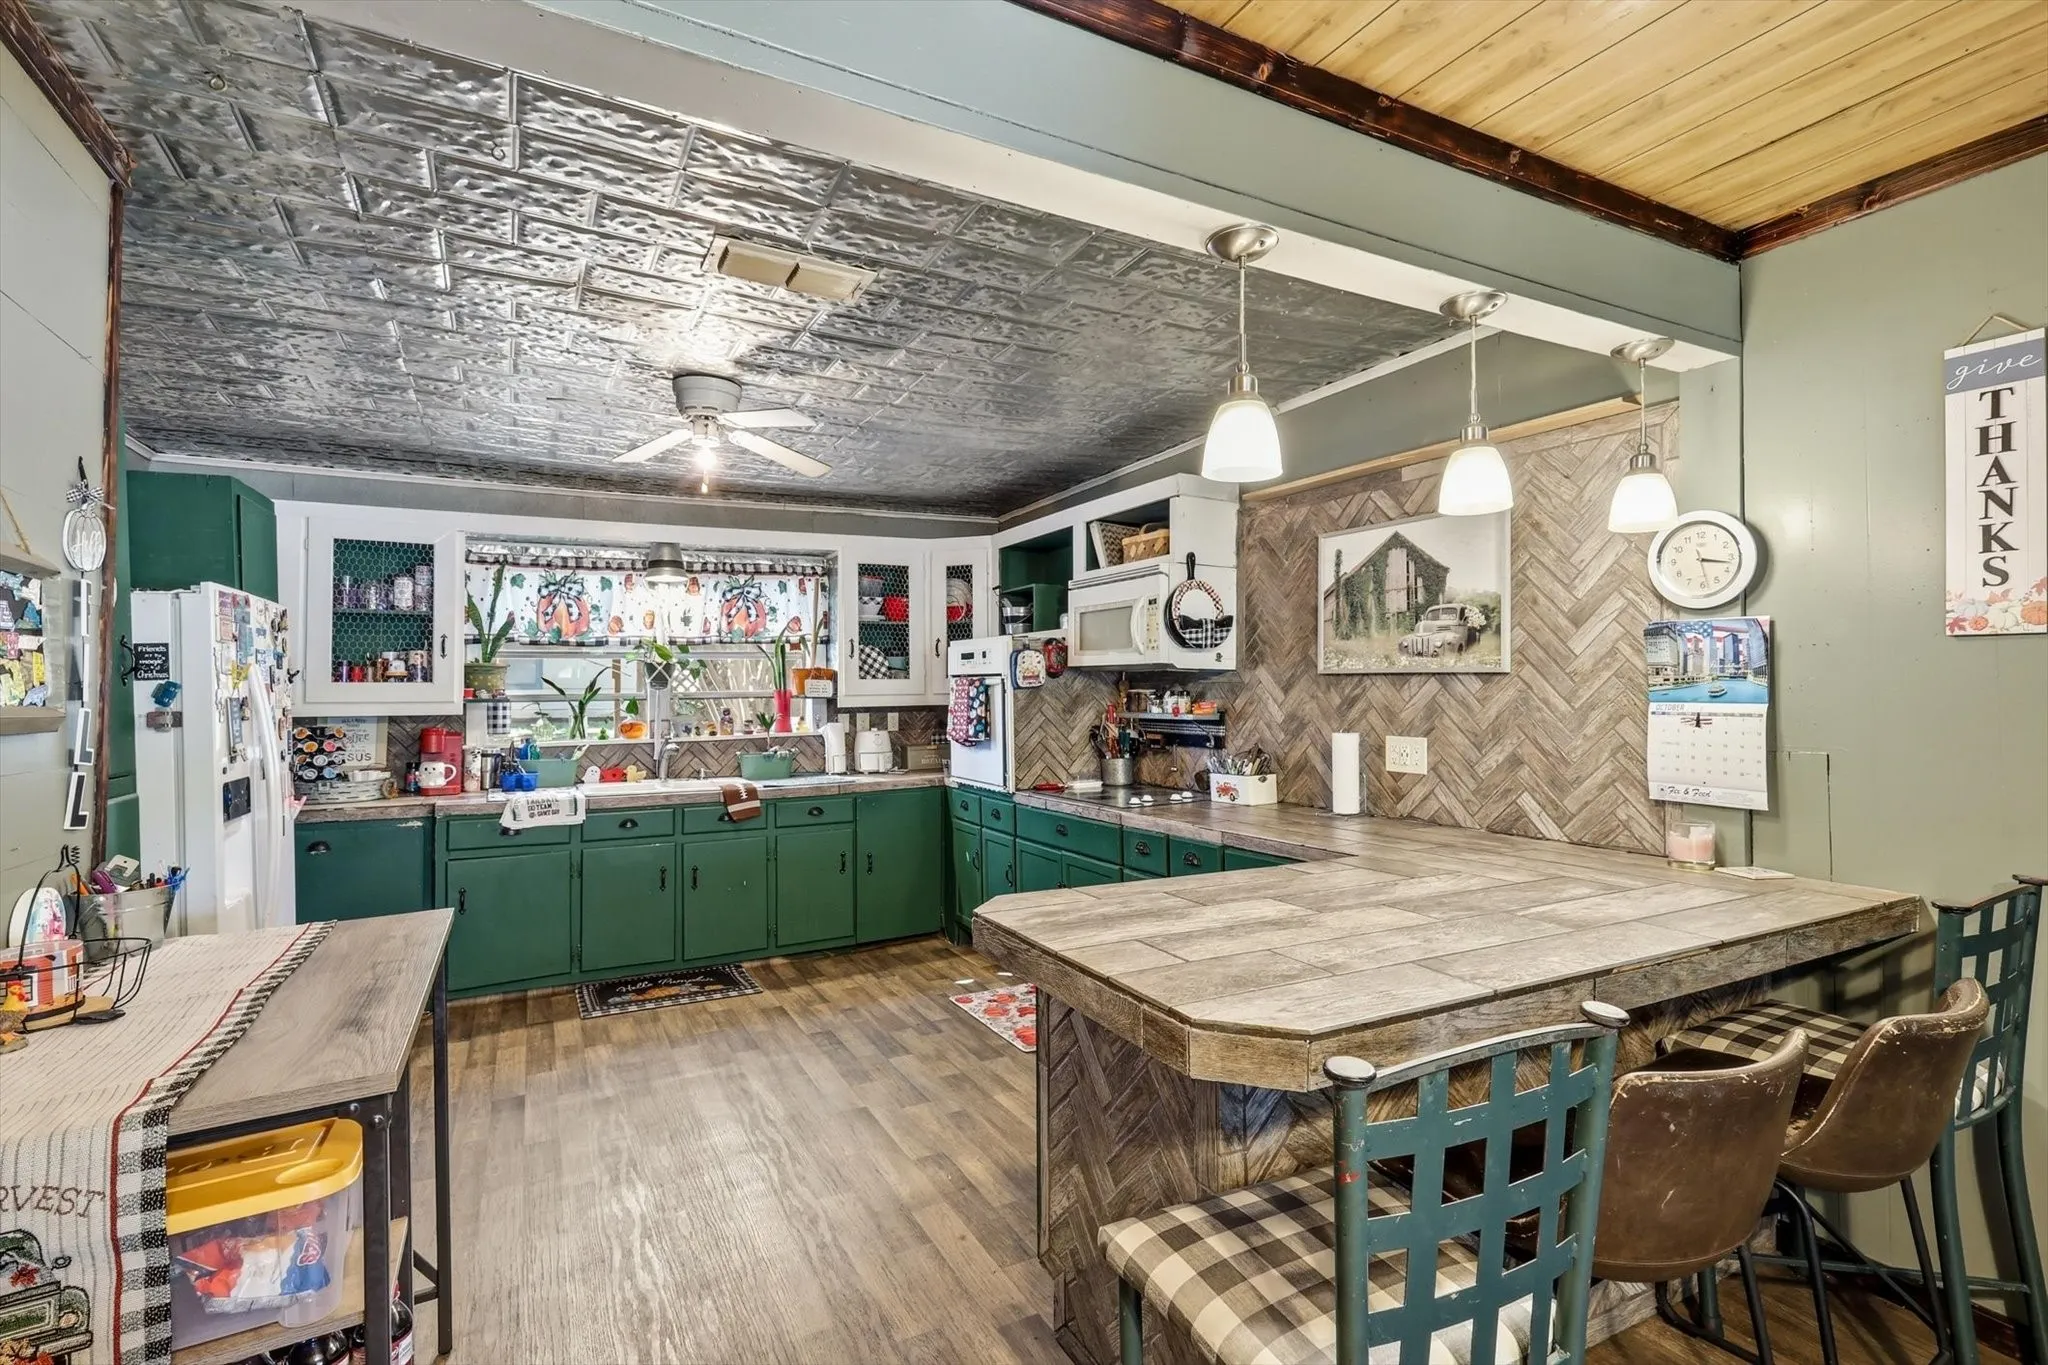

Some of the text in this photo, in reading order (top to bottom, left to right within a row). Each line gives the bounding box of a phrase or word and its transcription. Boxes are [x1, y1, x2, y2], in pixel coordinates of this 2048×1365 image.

[1946, 353, 2042, 391] give
[1975, 386, 2020, 588] THANKS
[1696, 531, 1706, 539] 12
[1684, 536, 1692, 544] 11
[1722, 541, 1729, 549] 2
[1674, 546, 1684, 554] 10
[1728, 553, 1735, 561] 3
[1671, 558, 1677, 566] 9
[1714, 576, 1721, 584] 5
[1700, 581, 1706, 589] 6
[138, 645, 167, 653] Friends
[137, 670, 169, 679] Christmas
[1655, 703, 1686, 711] OCTOBER
[536, 803, 553, 811] TEAM
[616, 981, 653, 992] Hello
